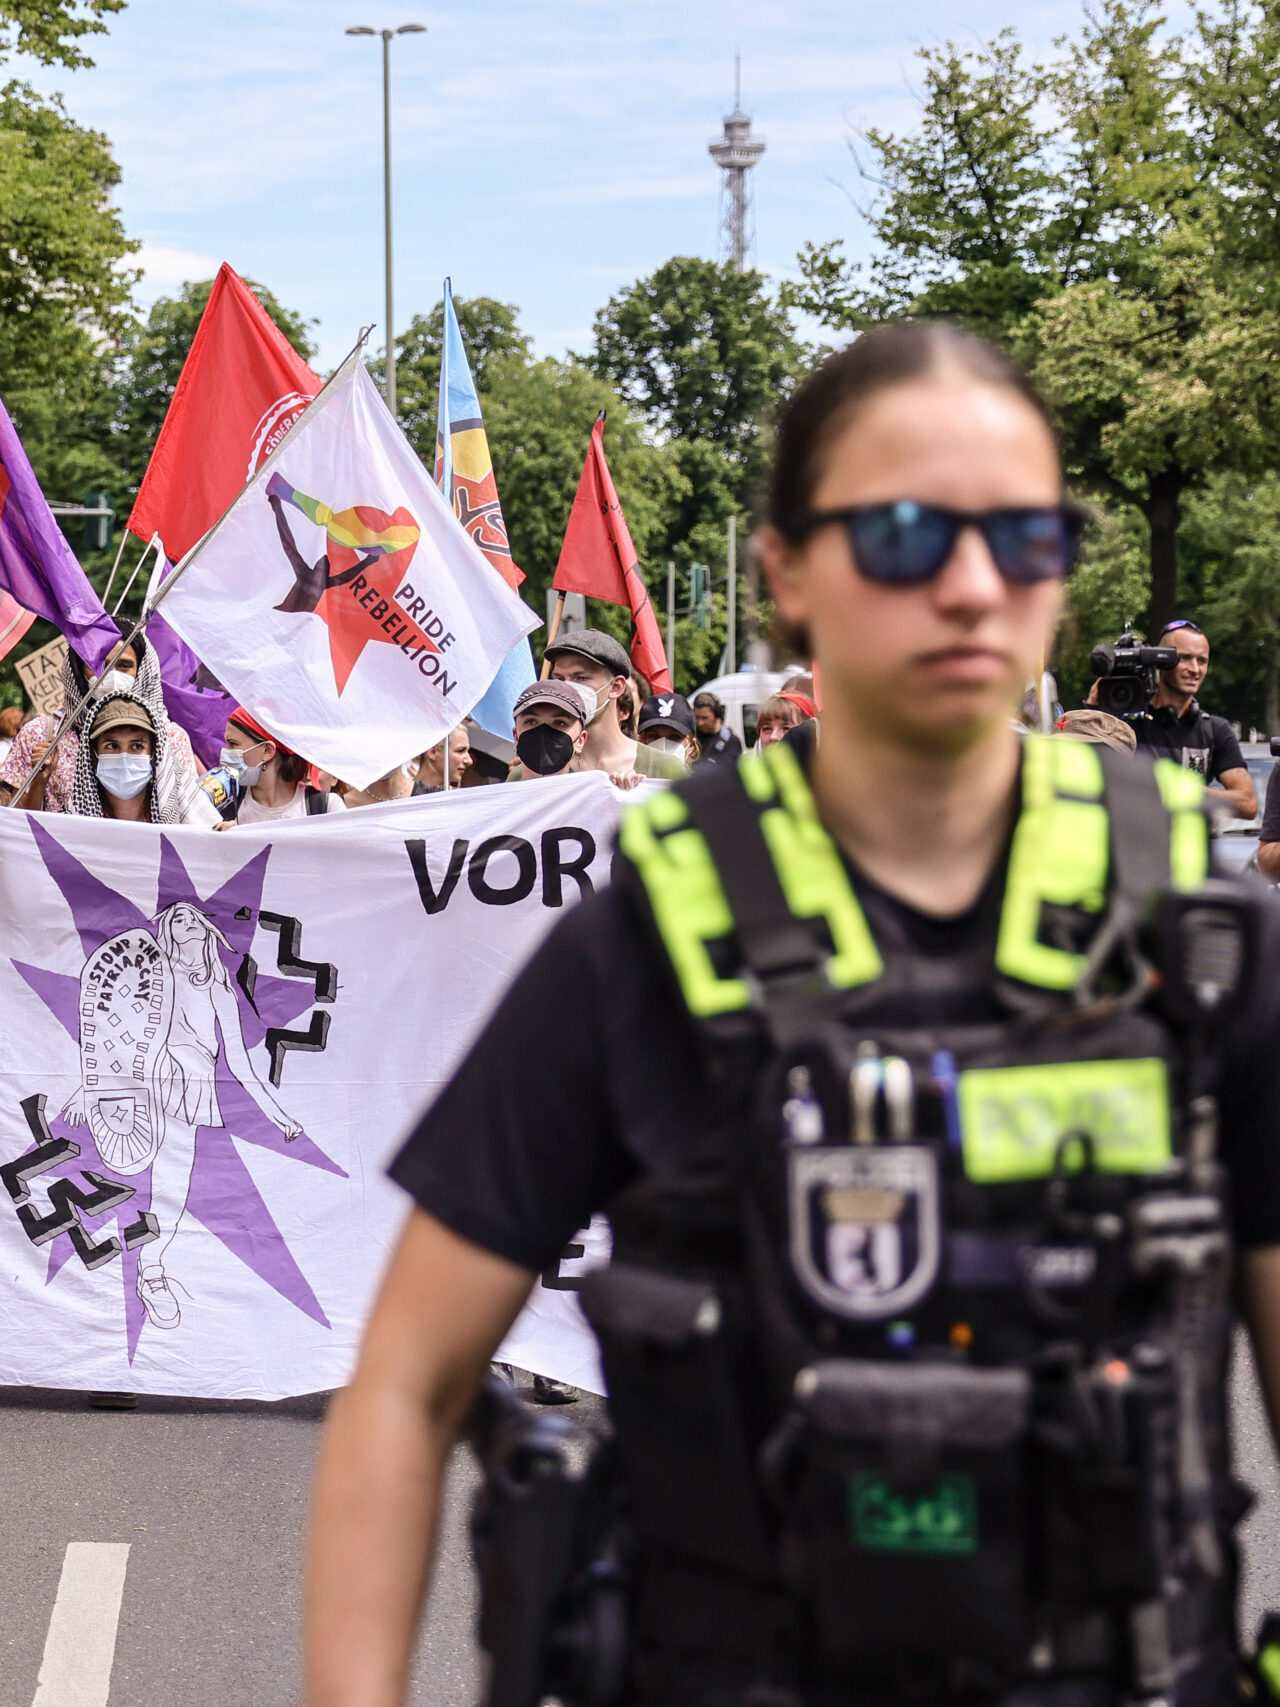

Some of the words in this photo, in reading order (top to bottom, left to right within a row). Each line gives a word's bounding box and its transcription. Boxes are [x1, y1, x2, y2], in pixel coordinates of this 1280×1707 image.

[349, 574, 458, 697] REBELLION
[394, 583, 456, 653] PRIDE
[405, 827, 616, 914] VOR
[89, 939, 130, 984] STOMP
[138, 937, 160, 964] THE
[97, 954, 151, 1012] PATRIARCHY
